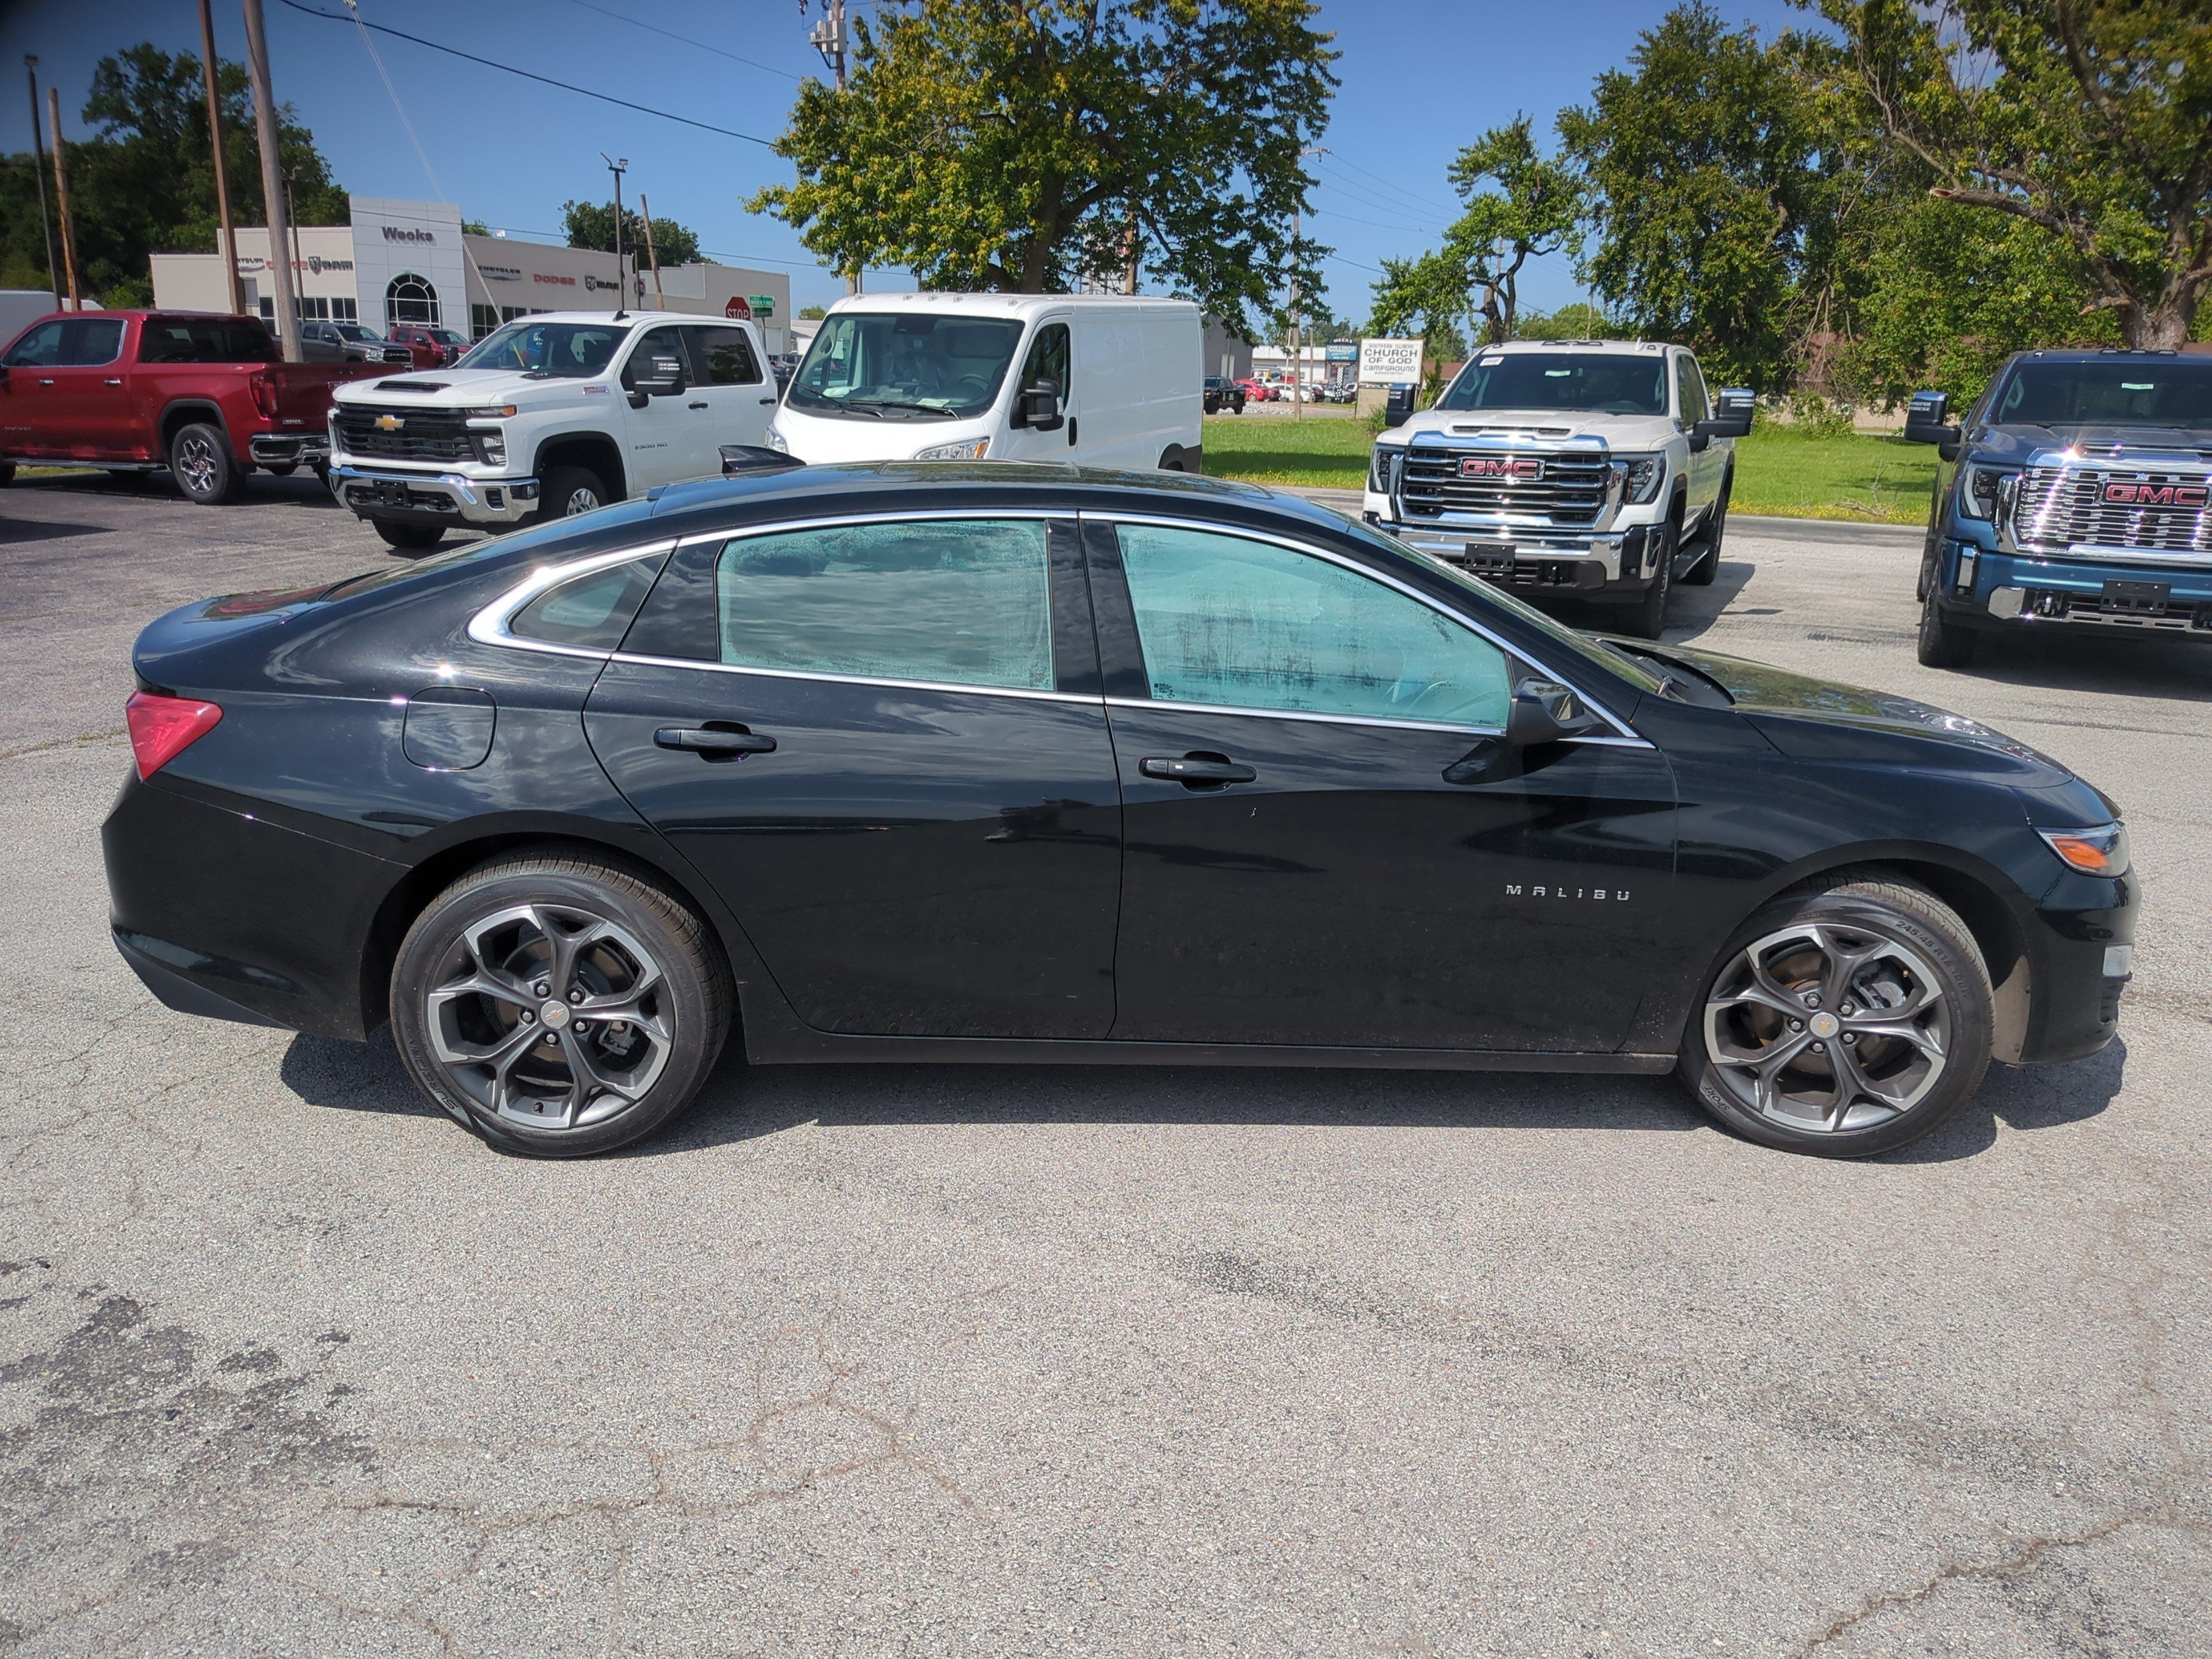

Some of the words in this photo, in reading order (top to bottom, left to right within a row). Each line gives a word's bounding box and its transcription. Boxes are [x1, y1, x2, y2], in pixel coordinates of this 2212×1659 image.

[382, 227, 433, 241] Weeks
[322, 260, 353, 270] RAM
[478, 265, 520, 274] CHRYSLER
[533, 274, 576, 285] DODGE
[727, 309, 749, 319] STOP
[1364, 348, 1417, 357] CHURCH
[1463, 460, 1538, 476] GMC
[2106, 484, 2206, 504] GMC
[1506, 885, 1630, 900] MALIBU
[1896, 920, 1935, 947] 245/45
[1703, 1086, 1730, 1110] SPORT
